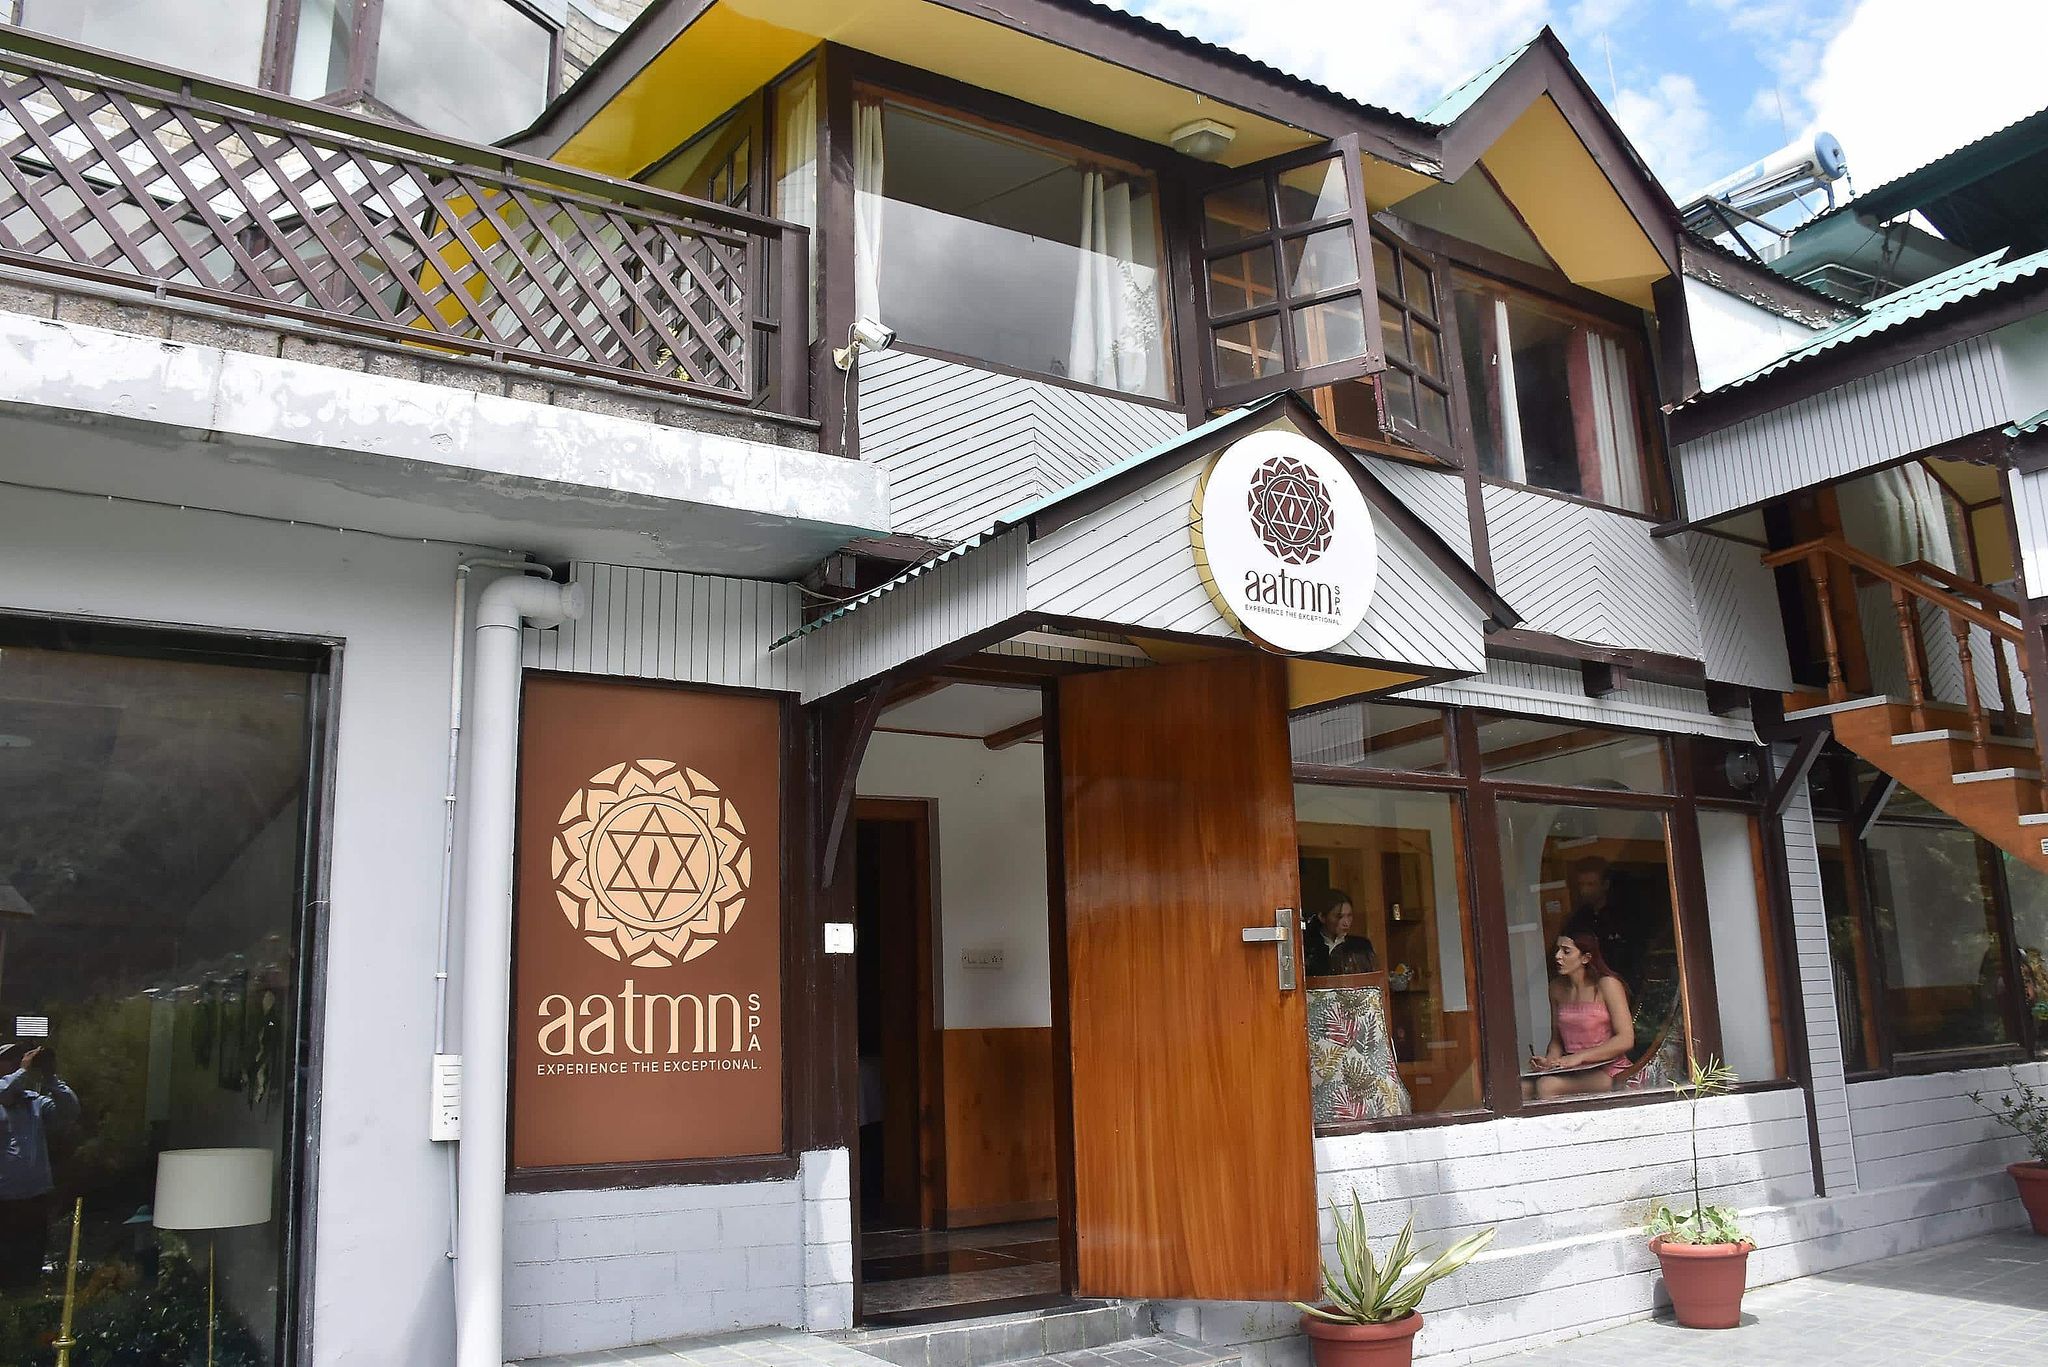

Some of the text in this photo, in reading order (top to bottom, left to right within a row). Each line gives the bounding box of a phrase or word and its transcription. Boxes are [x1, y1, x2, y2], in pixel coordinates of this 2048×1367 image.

[1244, 568, 1333, 615] aatmn
[1244, 603, 1284, 616] EXPERIENCE
[1285, 610, 1297, 619] THE
[537, 979, 762, 1056] aatmn SPA
[537, 1058, 762, 1075] EXPERIENCE THE EXCEPTIONAL.
